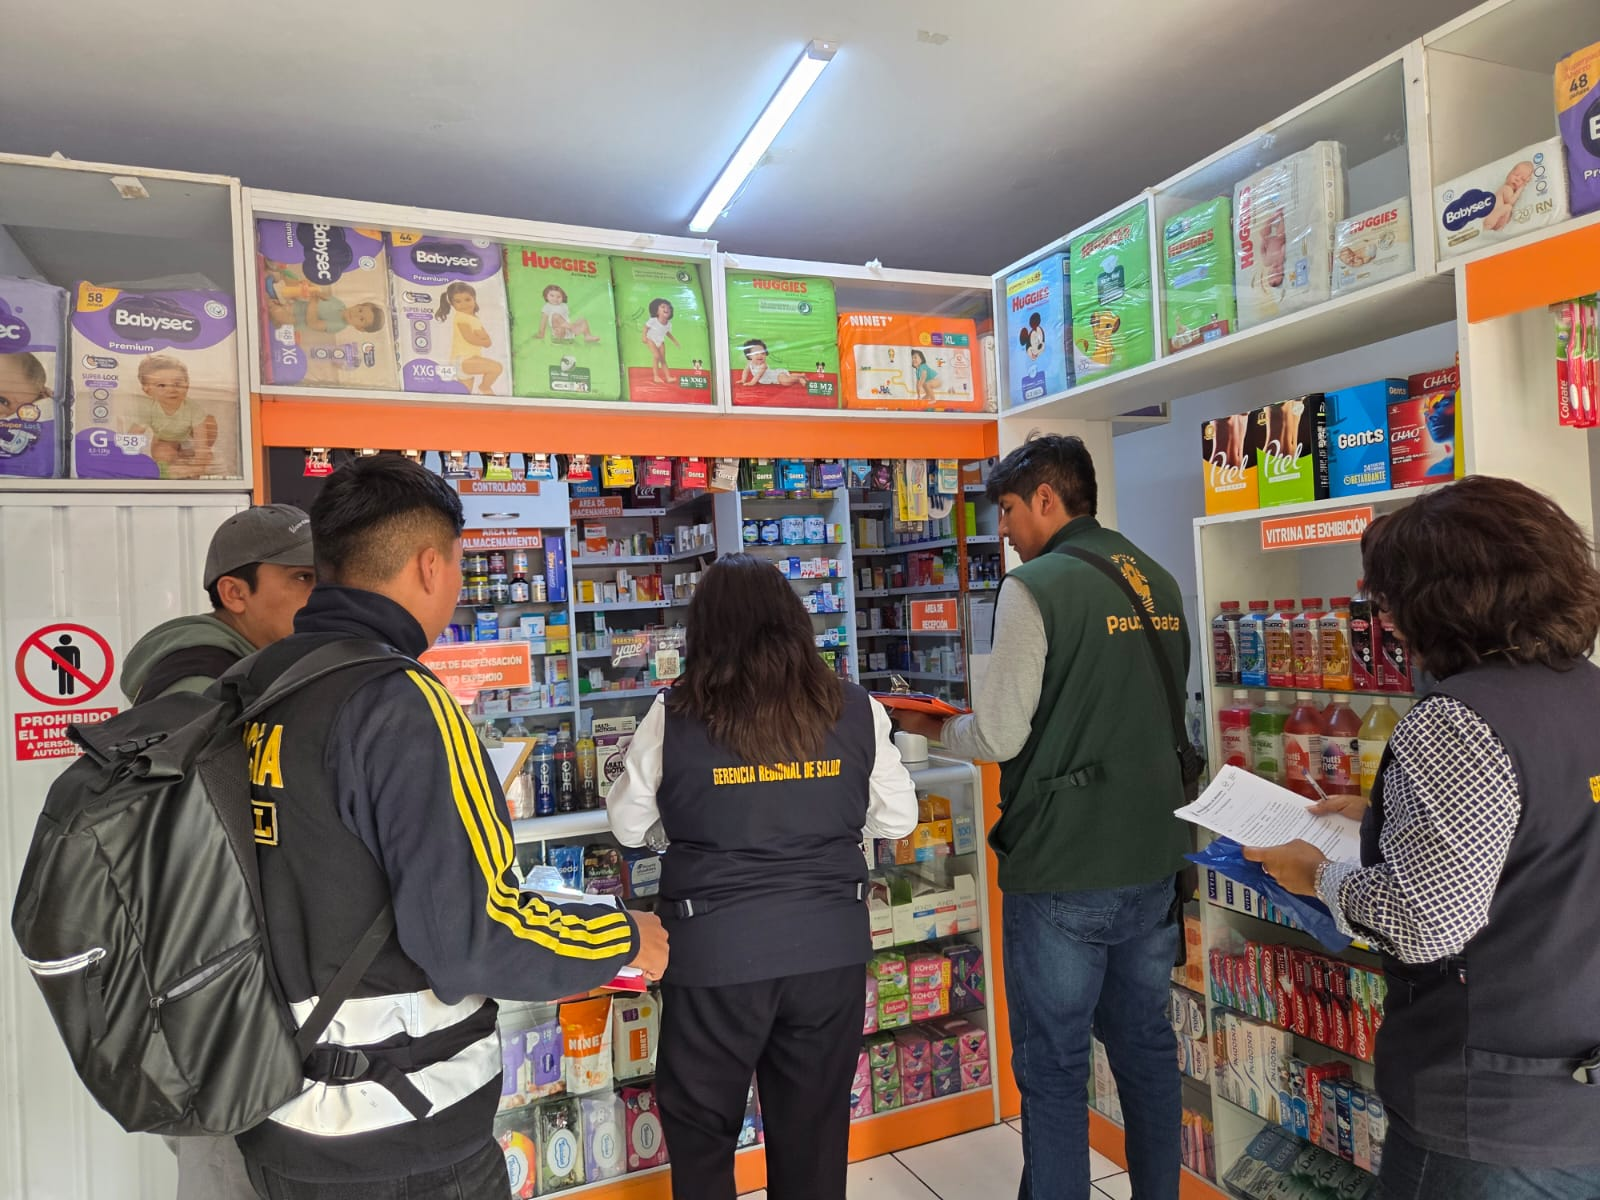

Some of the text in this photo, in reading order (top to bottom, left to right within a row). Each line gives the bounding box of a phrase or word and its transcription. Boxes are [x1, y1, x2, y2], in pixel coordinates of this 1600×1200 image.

[1570, 73, 1588, 92] 48
[1446, 196, 1492, 224] Babysec
[1535, 198, 1553, 215] RN
[416, 250, 478, 268] Babysec
[522, 250, 598, 274] HUGGIES
[412, 274, 450, 283] Premium
[752, 278, 808, 294] HUGGIES
[88, 293, 103, 303] 58
[1012, 286, 1050, 312] HUGGIES
[116, 310, 193, 331] Babysec
[109, 342, 154, 352] Premium
[944, 335, 955, 344] XL
[282, 348, 298, 366] XG
[412, 365, 434, 377] XXG
[440, 367, 452, 375] 44
[1560, 380, 1569, 420] Colgate
[90, 430, 108, 448] G
[123, 436, 138, 446] 58
[1338, 428, 1385, 449] Gents
[1391, 428, 1420, 442] CHAO
[1264, 439, 1304, 479] Piel
[1210, 451, 1249, 489] Piel
[1350, 470, 1386, 485] RETARDANTE
[472, 482, 526, 492] CONTROLADOS
[596, 498, 605, 506] DE
[572, 507, 621, 517] MACENAMIENTO
[1266, 514, 1368, 544] VITRINA DE EXHIBICIÓN
[463, 536, 538, 548] ALMACENAMIENTO
[448, 660, 459, 669] DE
[462, 654, 523, 668] DISPENSACIÓN
[612, 643, 642, 667] yape
[461, 672, 503, 683] EXPENDIO
[21, 711, 112, 727] PROHIBIDO
[19, 730, 39, 741] EL
[37, 740, 77, 749] PERSO
[712, 759, 841, 785] GERENCIA REGIONAL DE SALUD
[559, 865, 578, 874] seda
[1248, 946, 1258, 990] Colgate
[1264, 949, 1273, 992] Colgate
[1296, 993, 1304, 1034] Colgate
[1336, 1008, 1344, 1049] Colgate
[1356, 1010, 1366, 1059] Colgate
